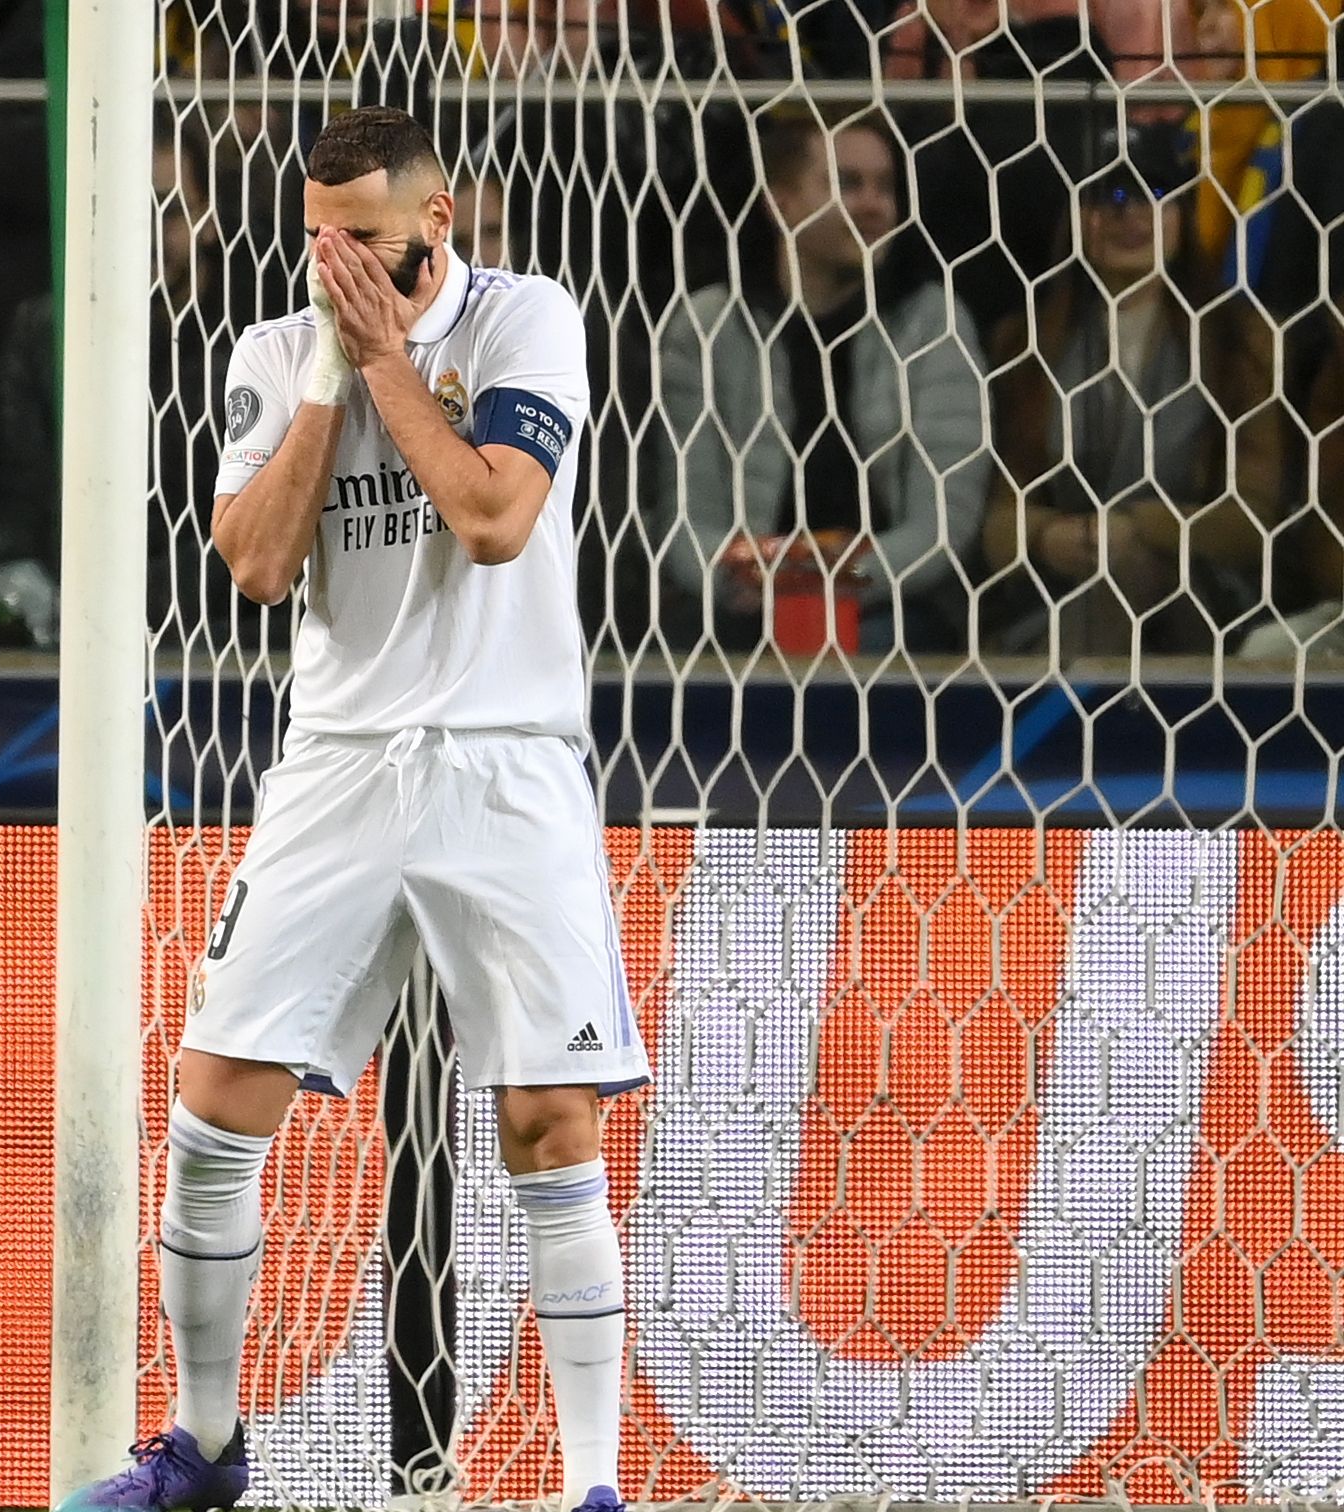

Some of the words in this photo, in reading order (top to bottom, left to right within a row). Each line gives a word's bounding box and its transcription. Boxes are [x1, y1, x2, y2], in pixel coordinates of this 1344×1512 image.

[515, 403, 537, 417] NO
[538, 411, 553, 427] TO
[321, 462, 424, 512] mira
[344, 515, 376, 552] FLY
[207, 879, 249, 961] 9
[541, 1281, 614, 1304] RMCF
